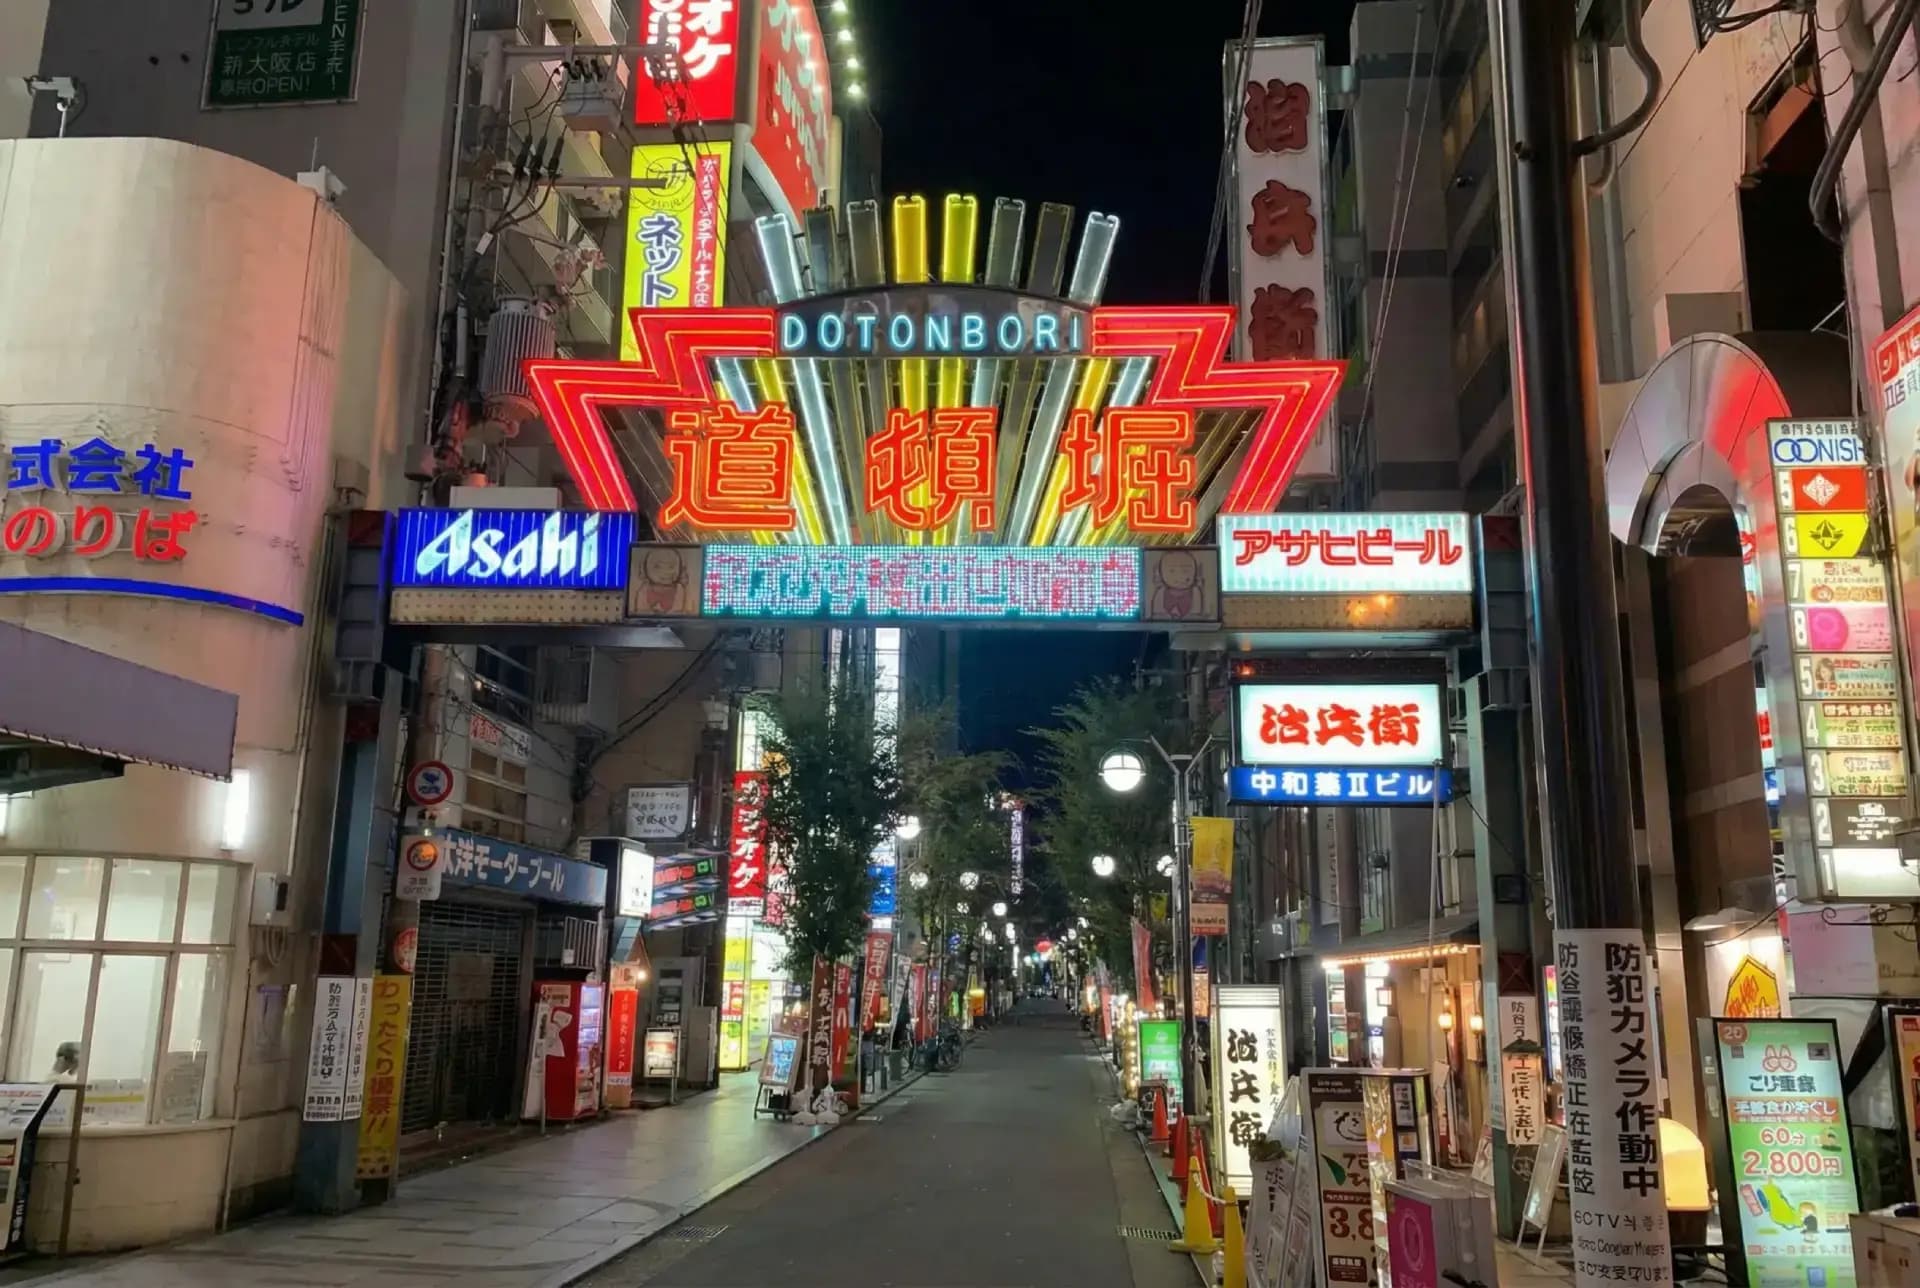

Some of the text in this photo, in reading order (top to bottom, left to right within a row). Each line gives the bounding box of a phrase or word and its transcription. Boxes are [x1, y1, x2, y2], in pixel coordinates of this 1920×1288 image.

[637, 213, 684, 308] ネット
[781, 313, 1082, 351] DOTONBORI
[8, 437, 194, 500] 式会社
[659, 401, 1198, 532] 道頓堀
[3, 505, 198, 561] のりば
[416, 508, 601, 579] Asahi
[1233, 529, 1462, 566] アサヒビール
[1604, 942, 1661, 1198] 防犯カメラ作動中
